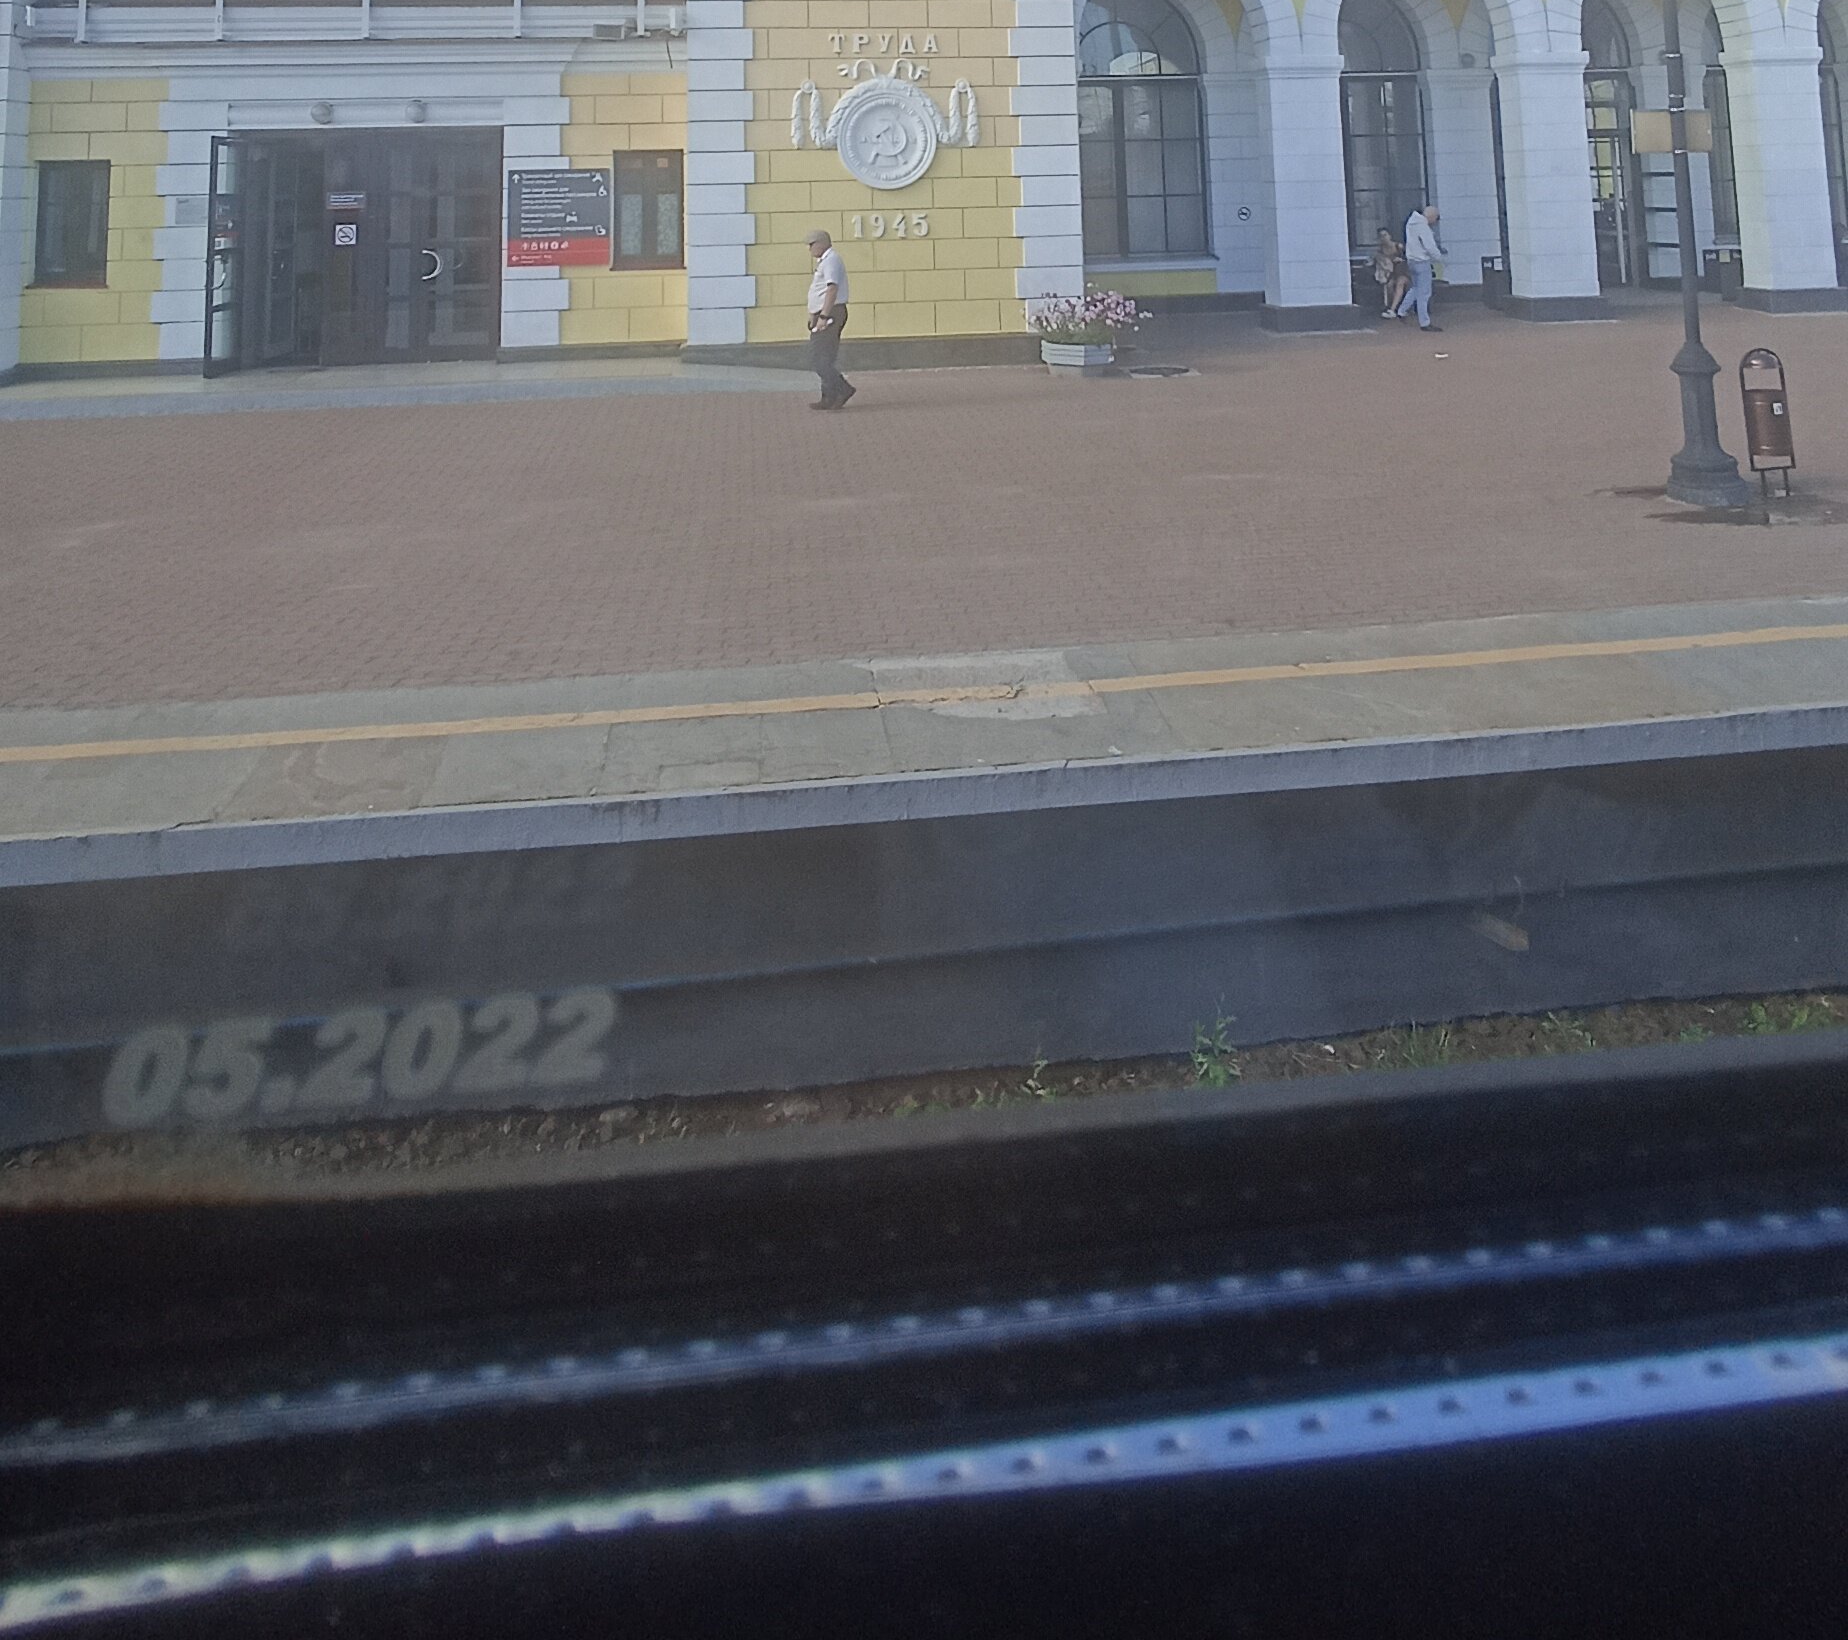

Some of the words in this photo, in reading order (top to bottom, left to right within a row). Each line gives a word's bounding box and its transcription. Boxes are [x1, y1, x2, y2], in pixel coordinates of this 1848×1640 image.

[829, 33, 939, 55] ТРУДА
[852, 213, 930, 238] 1945
[102, 985, 617, 1128] 05.2022
